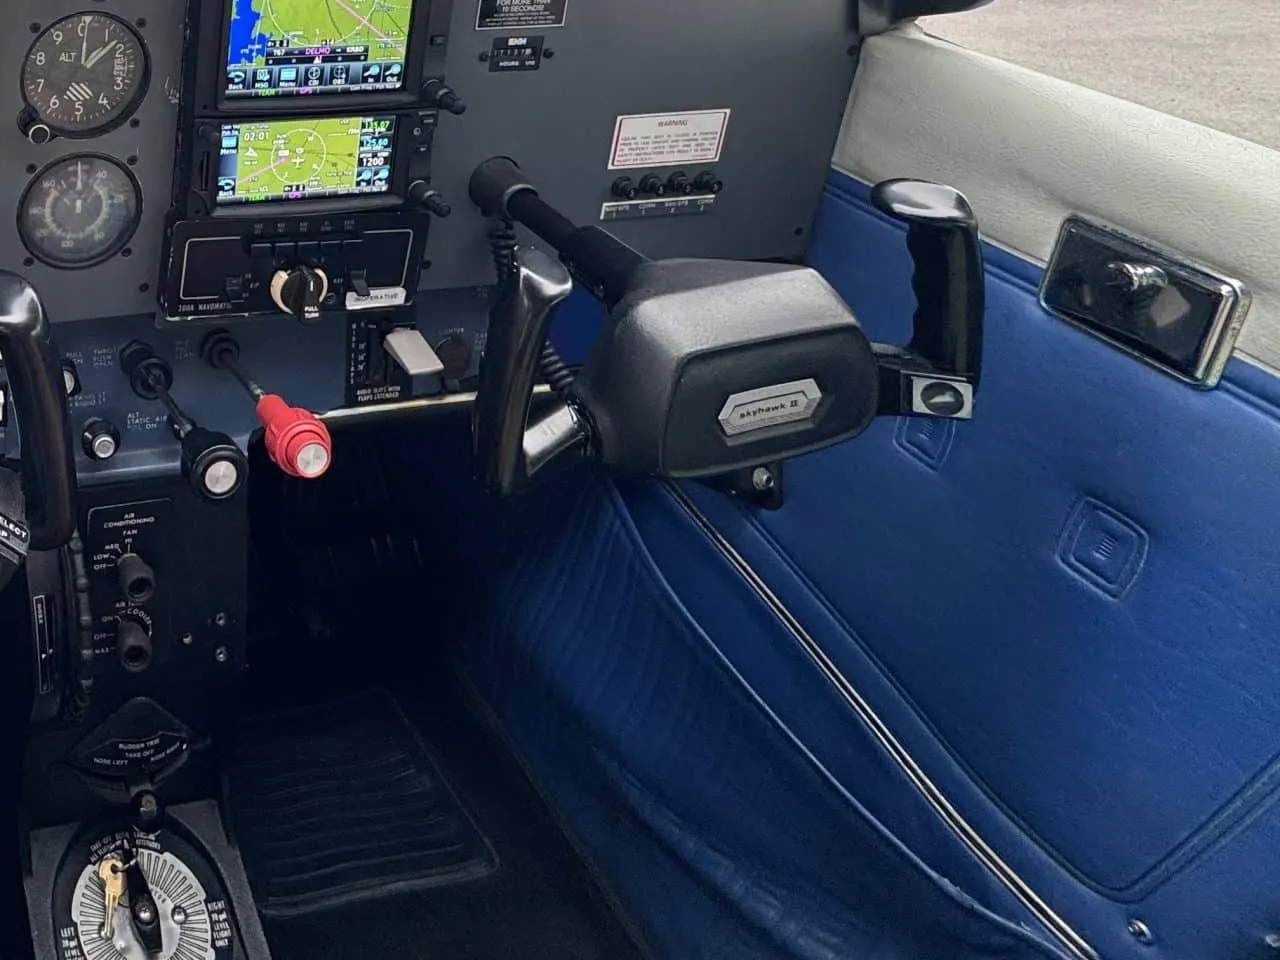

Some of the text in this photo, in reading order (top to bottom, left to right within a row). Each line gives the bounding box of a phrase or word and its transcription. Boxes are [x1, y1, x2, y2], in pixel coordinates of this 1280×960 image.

[53, 32, 62, 45] 9
[116, 44, 124, 57] 2
[36, 52, 45, 65] 8
[59, 52, 76, 62] ALT
[36, 80, 44, 92] 7
[114, 78, 122, 90] 3
[50, 96, 59, 108] 6
[98, 93, 108, 104] 4
[75, 102, 84, 114] 5
[362, 158, 384, 166] 1200
[740, 400, 798, 419] skyhawk II
[104, 516, 154, 528] CONDITIONING
[208, 901, 224, 910] RIGHT
[60, 928, 74, 936] LEFT
[213, 930, 231, 938] FLIGHT
